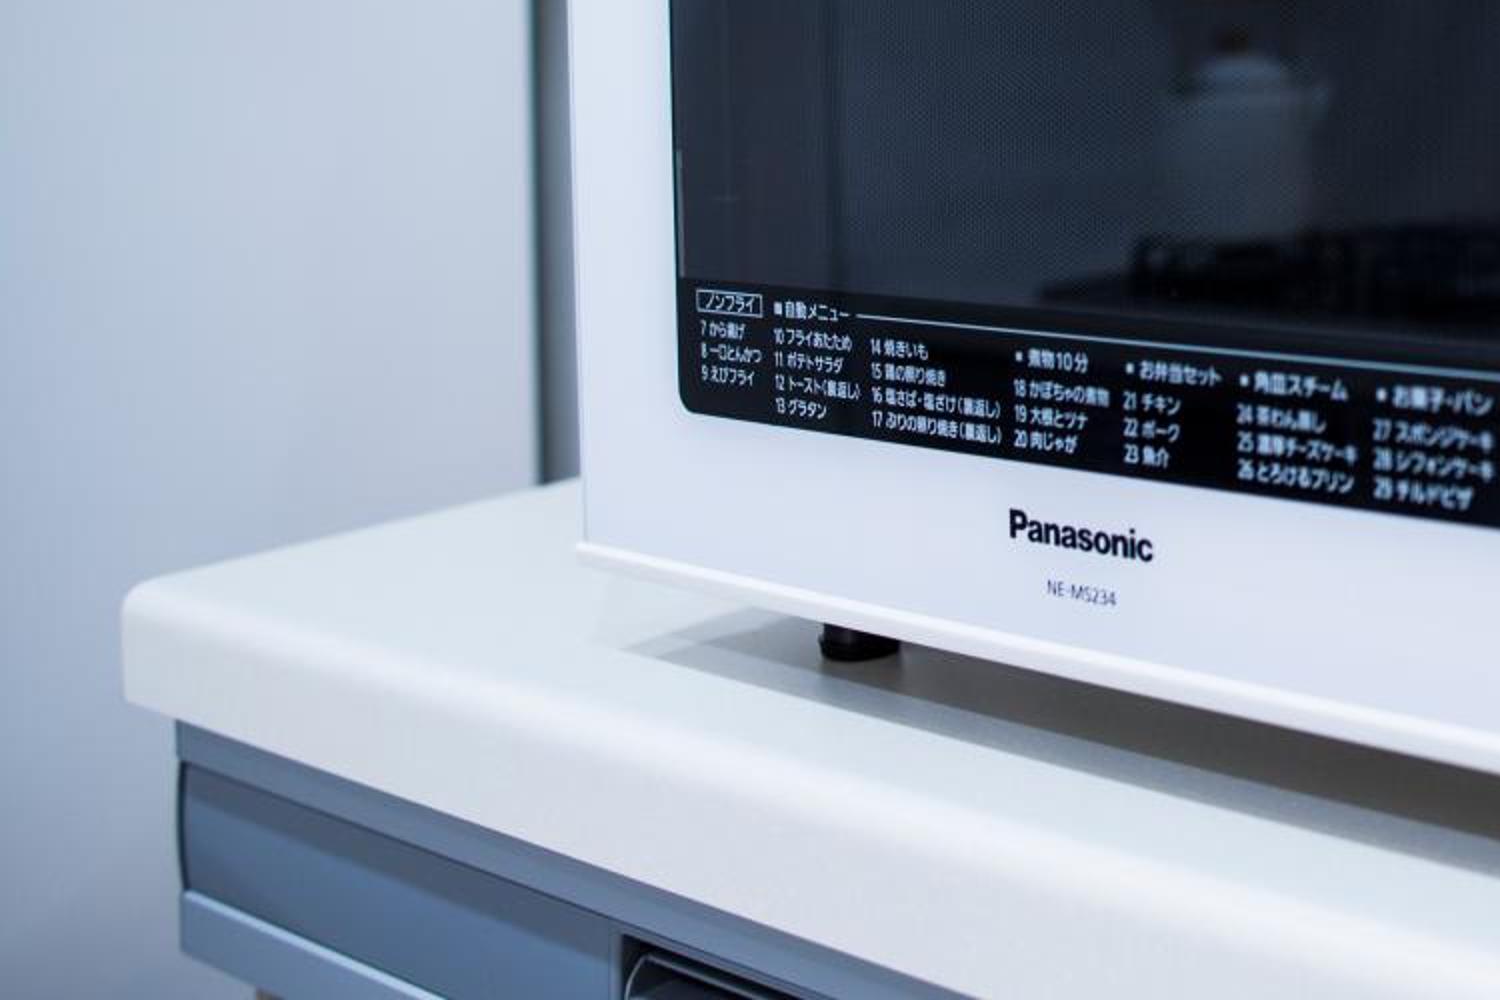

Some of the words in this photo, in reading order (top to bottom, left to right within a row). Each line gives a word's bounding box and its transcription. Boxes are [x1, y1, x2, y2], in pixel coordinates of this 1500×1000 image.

[705, 291, 755, 314] ノンフライ
[785, 301, 850, 322] 自動メニュー
[701, 320, 706, 336] 7
[709, 321, 746, 341] から揚げ
[774, 328, 784, 345] 10
[787, 329, 853, 352] フライあたため
[701, 343, 708, 359] 8
[710, 344, 762, 364] 一口とんかつ
[870, 338, 881, 356] 14
[884, 339, 929, 361] 焼きいも
[774, 352, 783, 367] 11
[787, 354, 844, 374] ポテトサラダ
[871, 362, 882, 380] 15
[1139, 360, 1221, 387] お弁当セット
[701, 366, 708, 382] 9
[711, 366, 755, 387] えびフライ
[775, 375, 785, 391] 12
[872, 386, 882, 404] 16
[1013, 379, 1027, 398] 18
[1029, 380, 1110, 408] かぼちゃの煮物
[1123, 391, 1137, 411] 21
[1141, 393, 1181, 415] チキン
[776, 398, 785, 414] 13
[788, 399, 827, 420] グラタン
[872, 410, 882, 428] 17
[1014, 404, 1027, 423] 19
[1029, 407, 1089, 430] 大根とツナ
[1014, 429, 1028, 449] 20
[1029, 432, 1078, 455] 肉じゃが
[1123, 418, 1138, 438] 22
[1141, 420, 1180, 443] ポーク
[1395, 420, 1493, 452] スポンジケーキ
[1124, 443, 1139, 464] 23
[1257, 461, 1355, 494] とろけるプリン
[1009, 508, 1153, 563] Panasonic
[1047, 579, 1117, 606] NE-MS234
